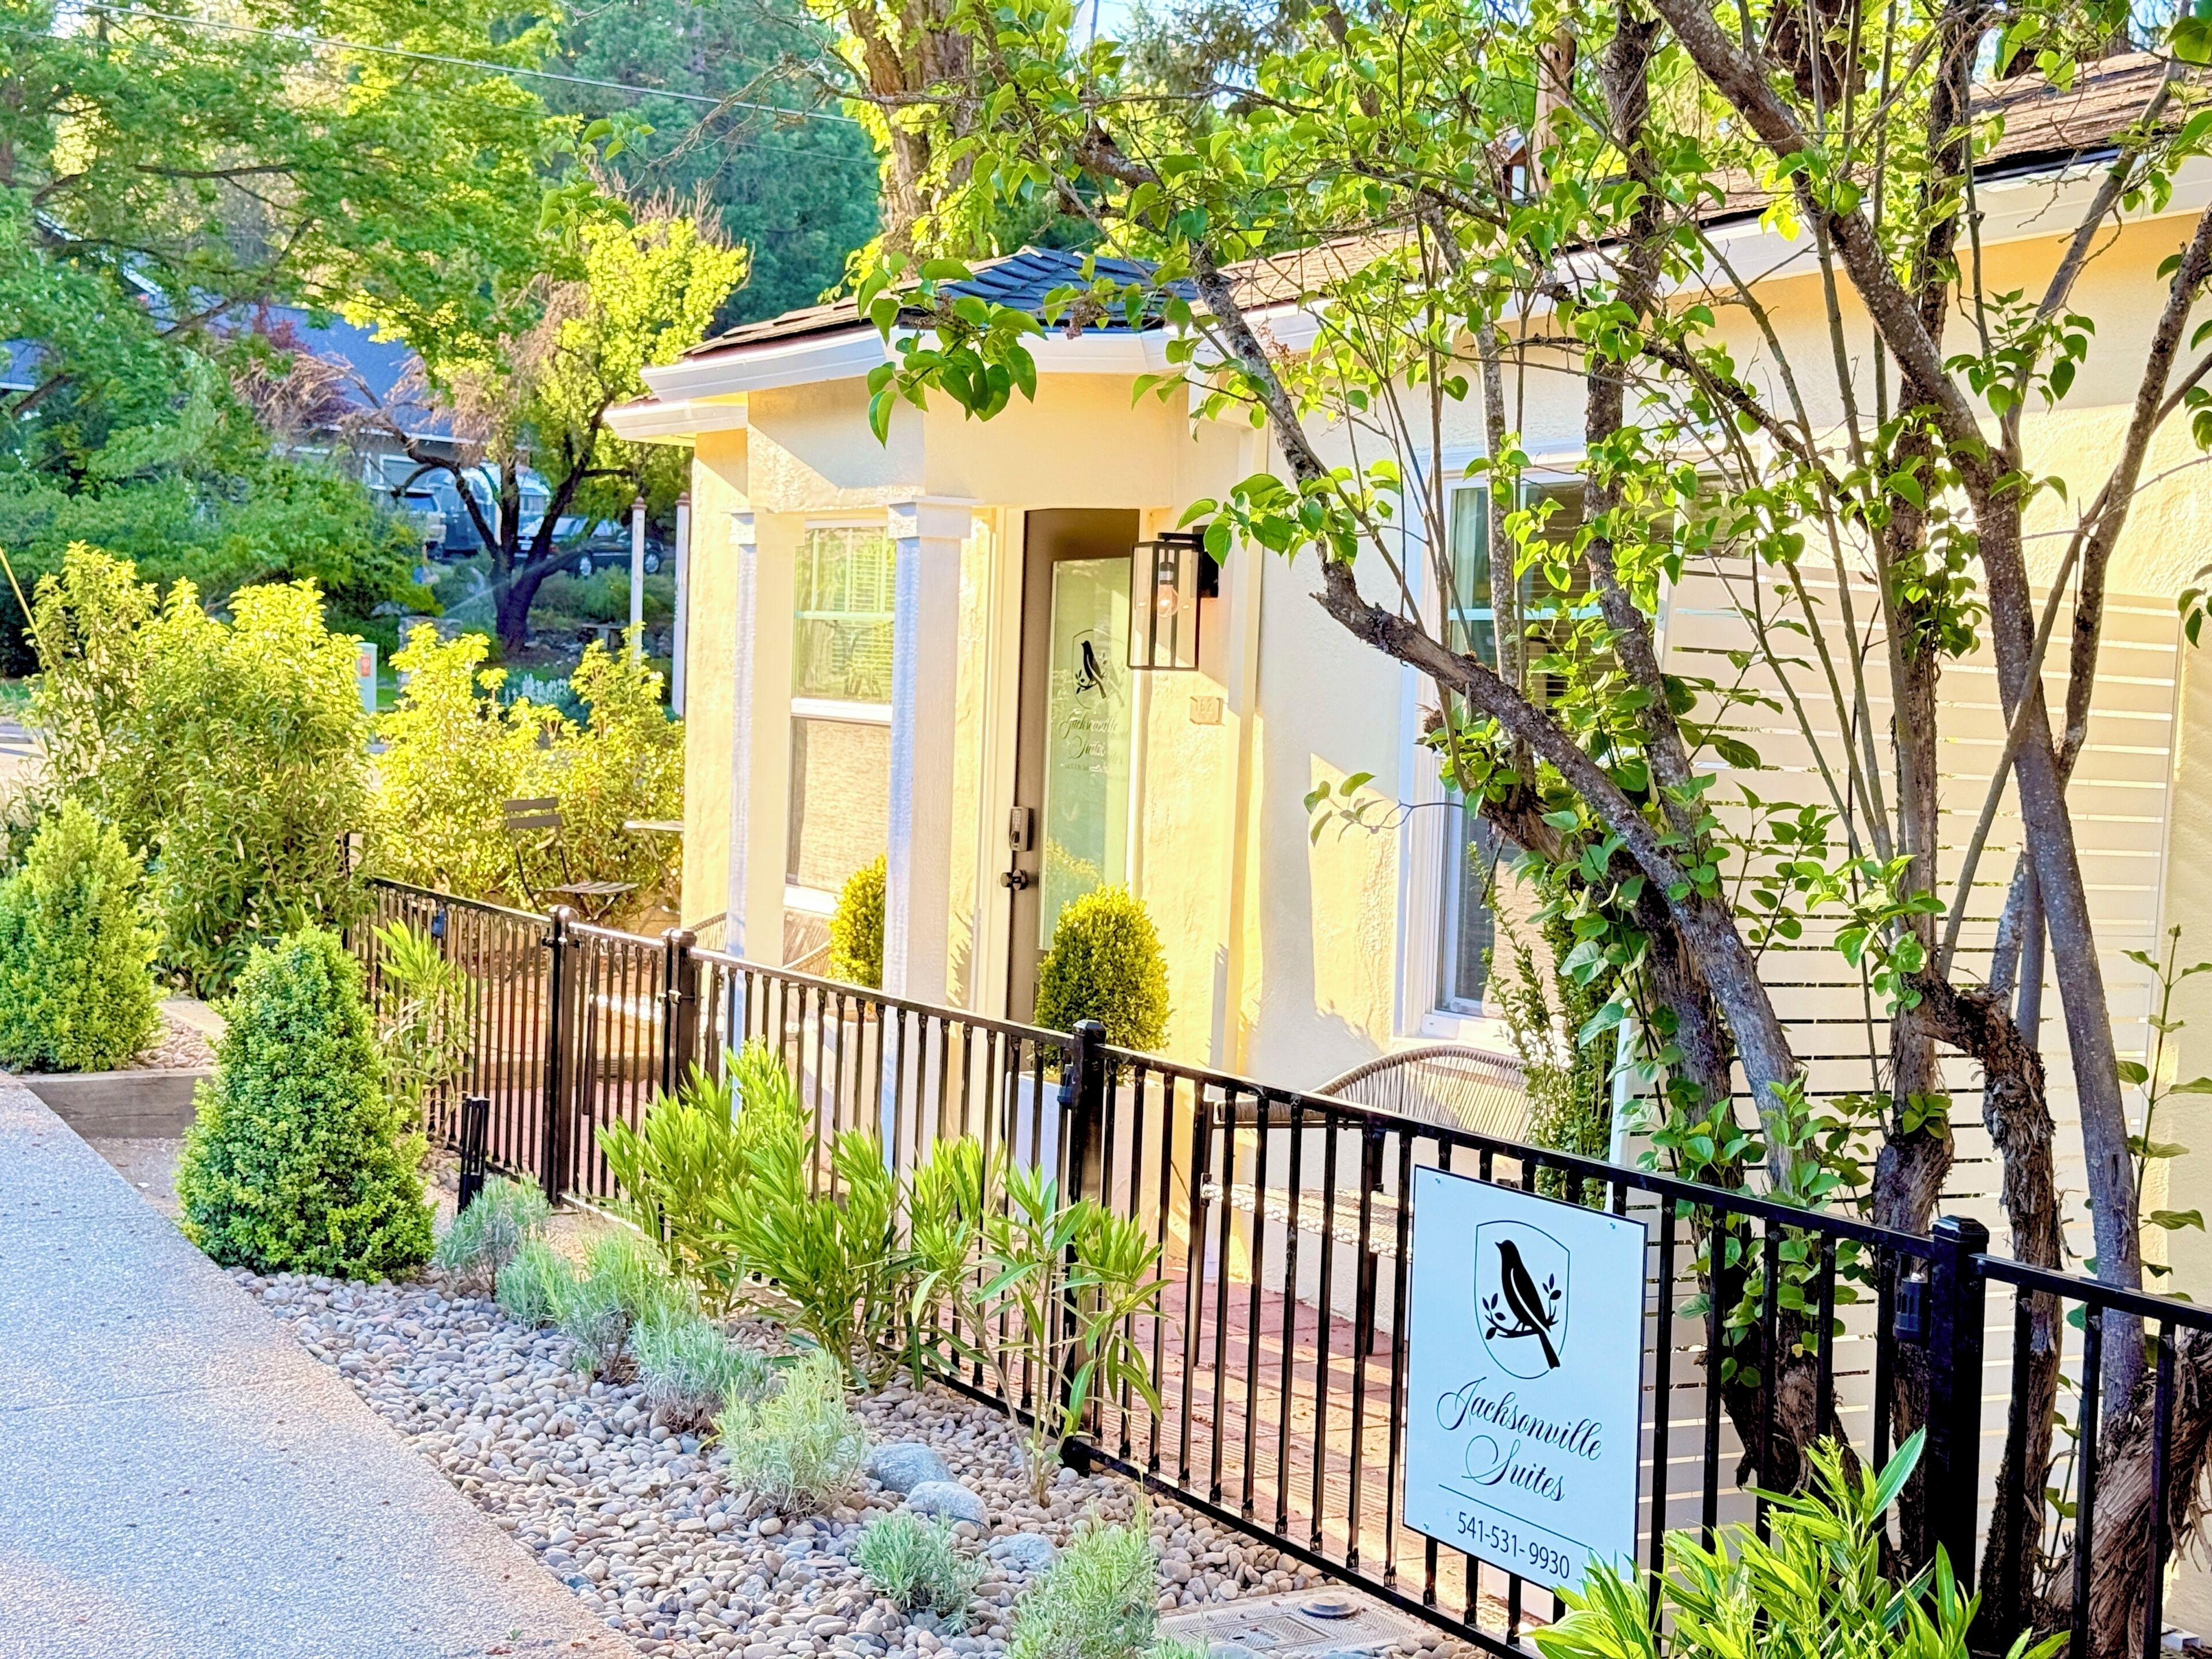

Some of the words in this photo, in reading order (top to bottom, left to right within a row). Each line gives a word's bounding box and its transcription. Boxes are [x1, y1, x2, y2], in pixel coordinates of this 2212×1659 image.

[1437, 1376, 1602, 1461] Jacksonville
[1461, 1434, 1565, 1502] Suites
[1457, 1511, 1570, 1579] 541-531-9930
